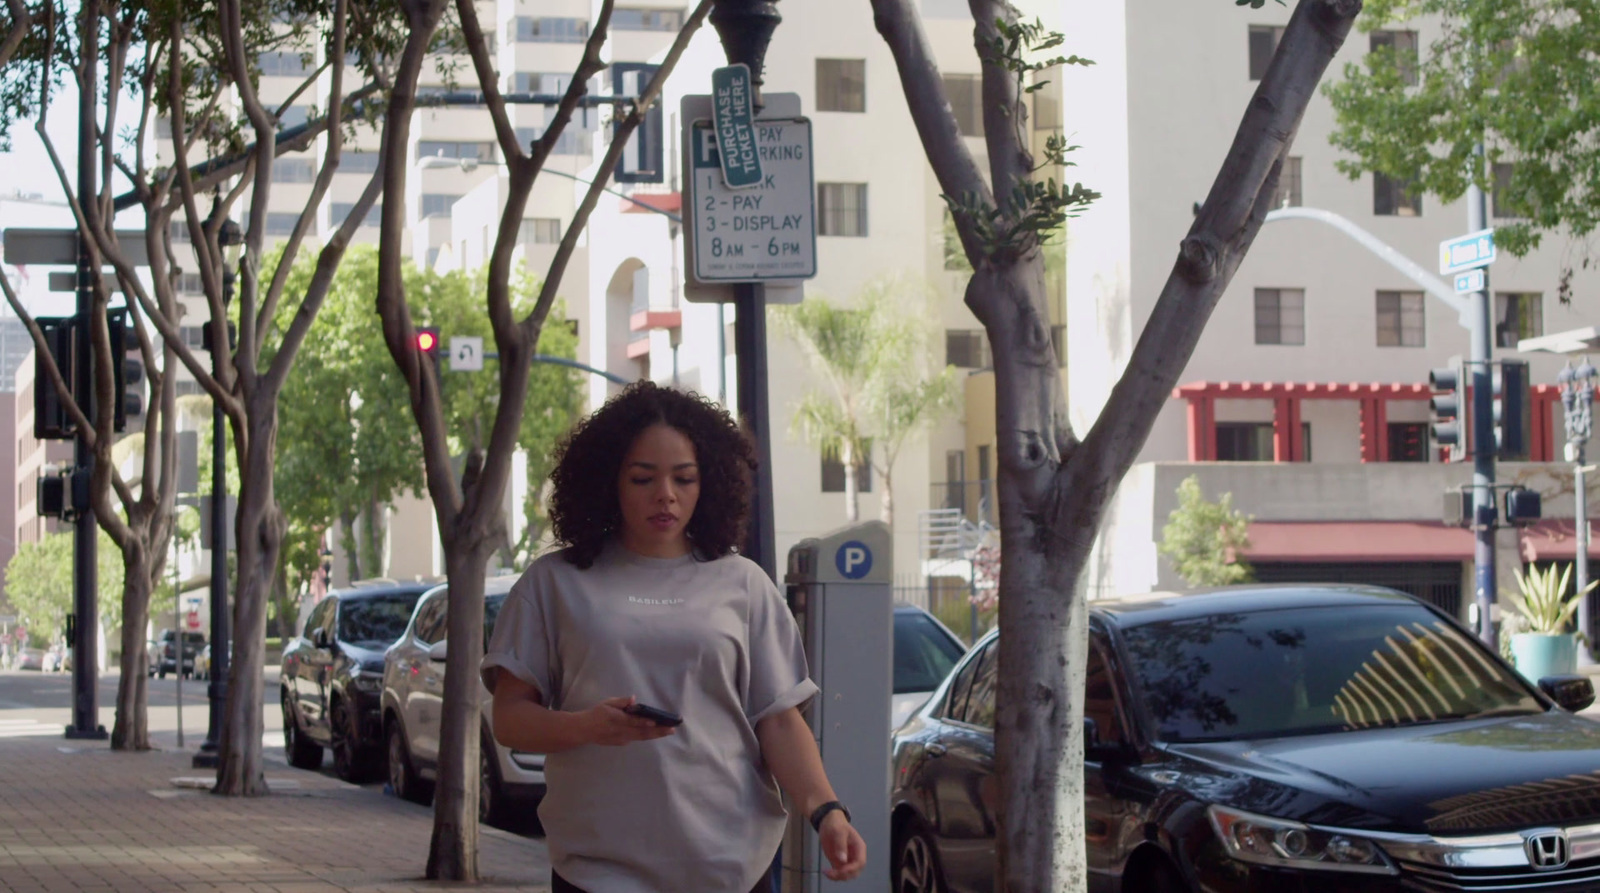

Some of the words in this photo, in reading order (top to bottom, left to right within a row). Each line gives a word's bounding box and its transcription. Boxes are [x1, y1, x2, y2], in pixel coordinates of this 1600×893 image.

[731, 76, 746, 118] HERE
[718, 86, 741, 169] PURCHASE
[759, 127, 783, 142] PAY
[735, 123, 757, 174] TICKET
[733, 195, 763, 210] PAY
[733, 215, 803, 231] DISPLAY
[845, 547, 866, 573] P
